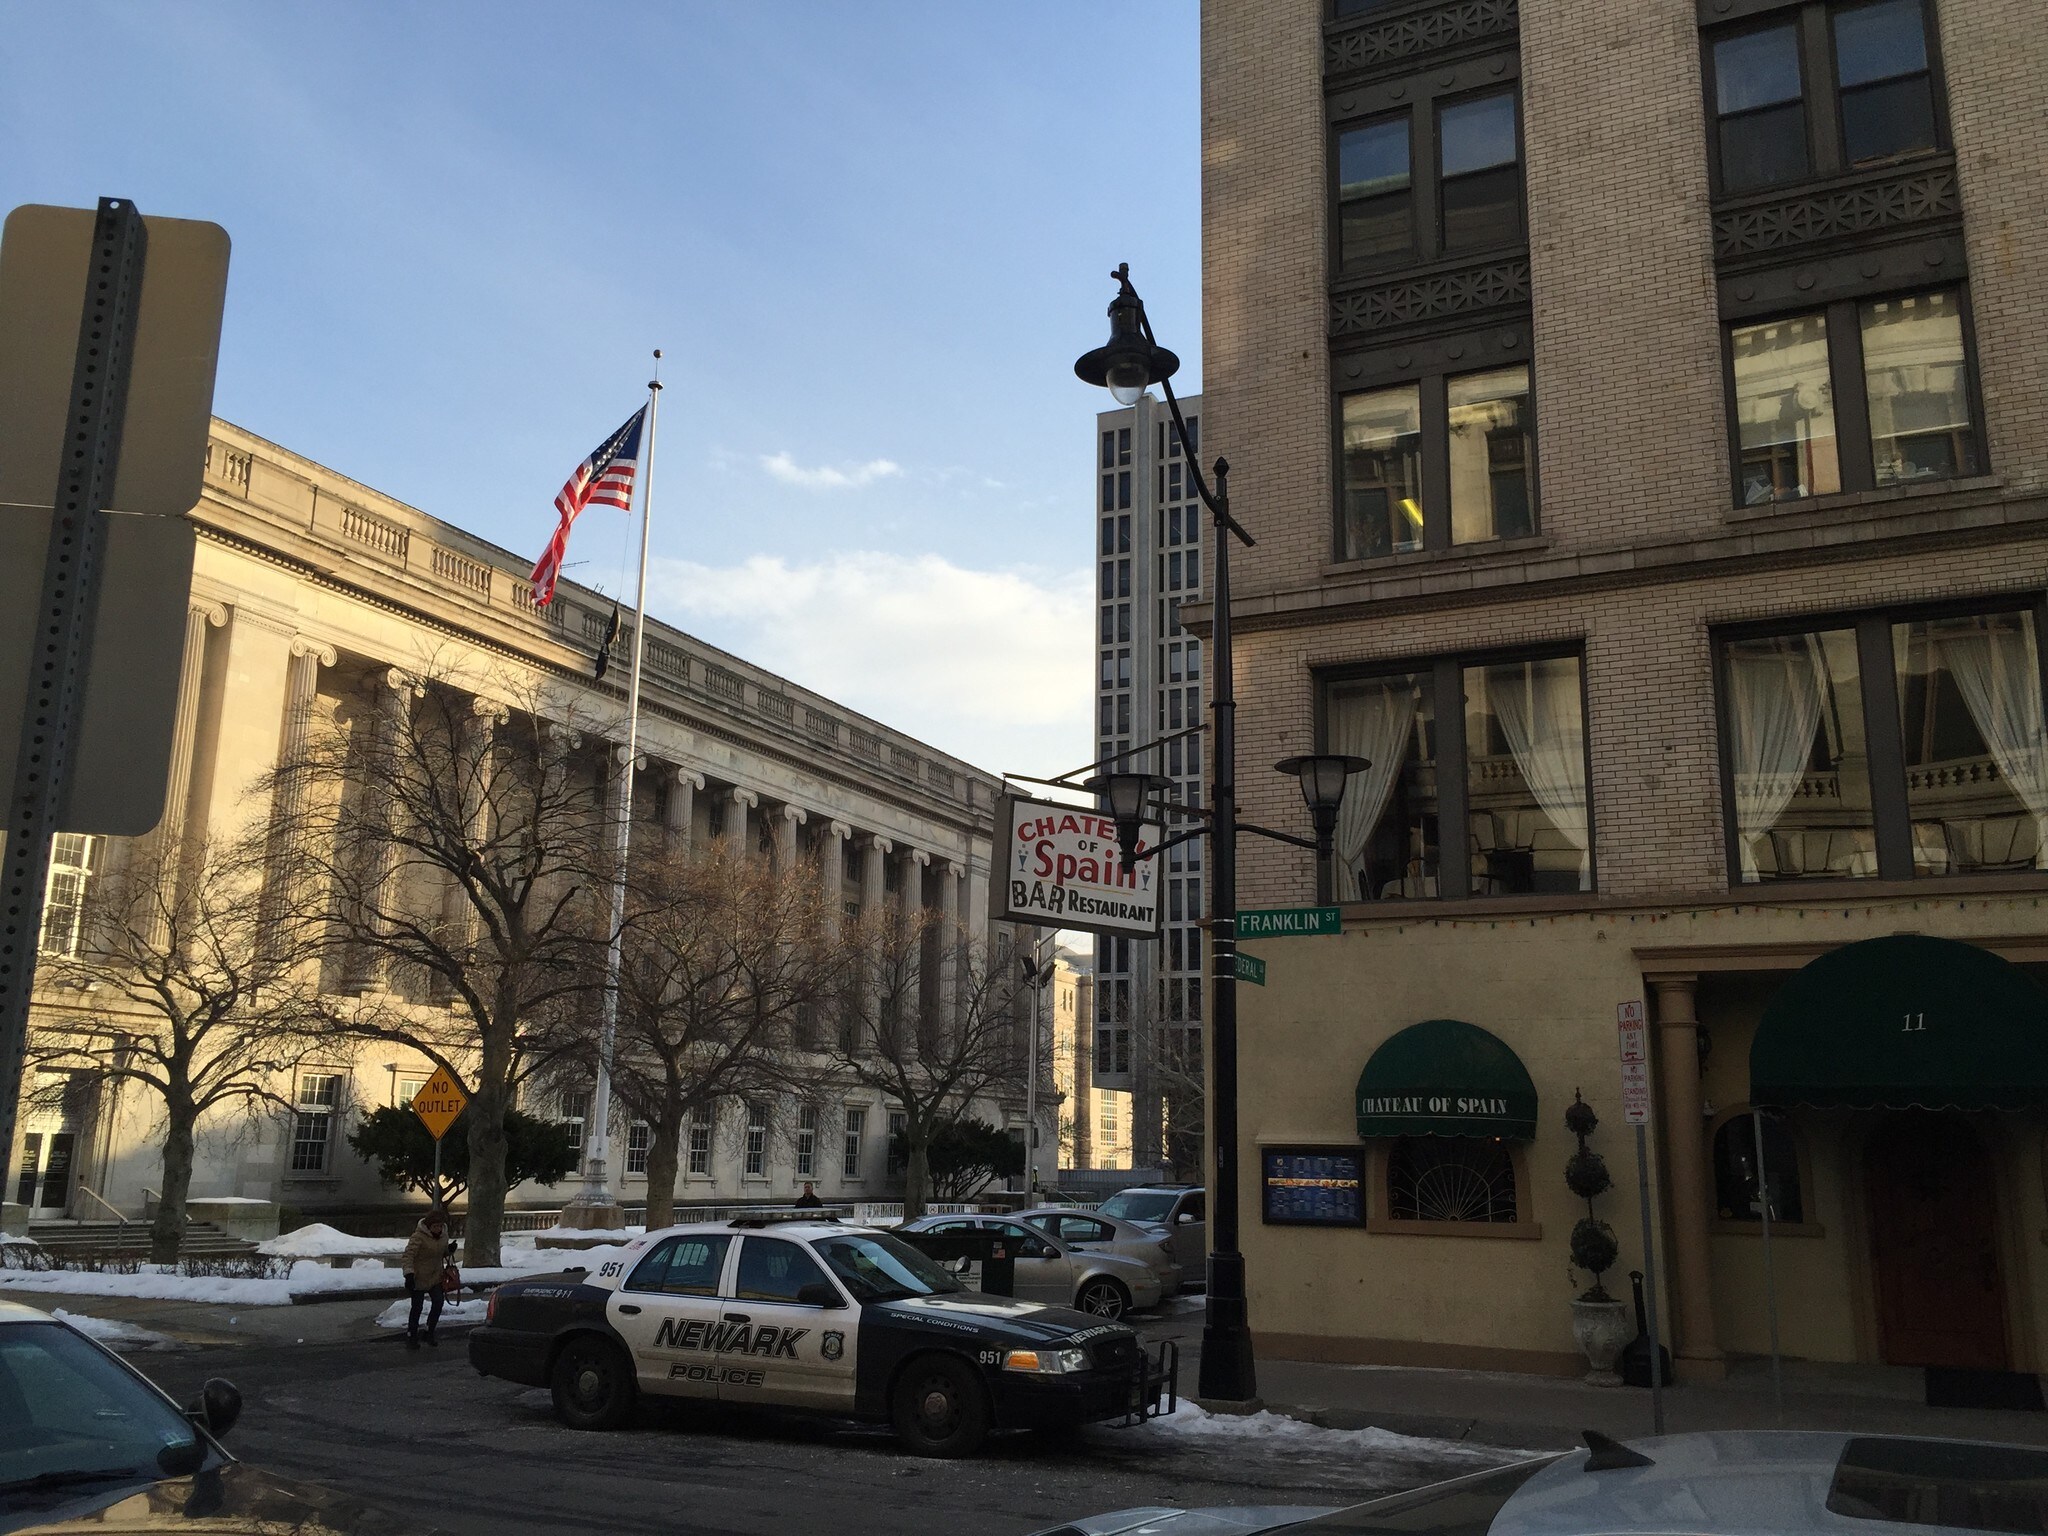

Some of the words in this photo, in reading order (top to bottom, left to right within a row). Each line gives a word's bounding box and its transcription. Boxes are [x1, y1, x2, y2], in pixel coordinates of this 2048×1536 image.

[1017, 815, 1153, 862] CHATE
[1078, 840, 1098, 853] OF
[1033, 839, 1137, 889] Spain
[1012, 880, 1066, 915] BAR
[1240, 913, 1320, 932] FRANKLIN
[1325, 912, 1336, 921] ST
[1624, 1006, 1635, 1018] NO
[1620, 1019, 1642, 1032] PARKING
[1902, 1012, 1927, 1032] 11
[432, 1081, 449, 1094] NO
[419, 1100, 460, 1113] OUTLET
[1362, 1097, 1423, 1114] CHATEAU
[1429, 1097, 1451, 1113] OF
[1457, 1097, 1507, 1115] SPAIN
[599, 1261, 625, 1278] 951
[890, 1312, 925, 1323] SPECIAL
[926, 1318, 980, 1334] CONDITIONS
[653, 1317, 811, 1360] NEWARK
[979, 1351, 1000, 1365] 951
[668, 1362, 766, 1388] POLICE
